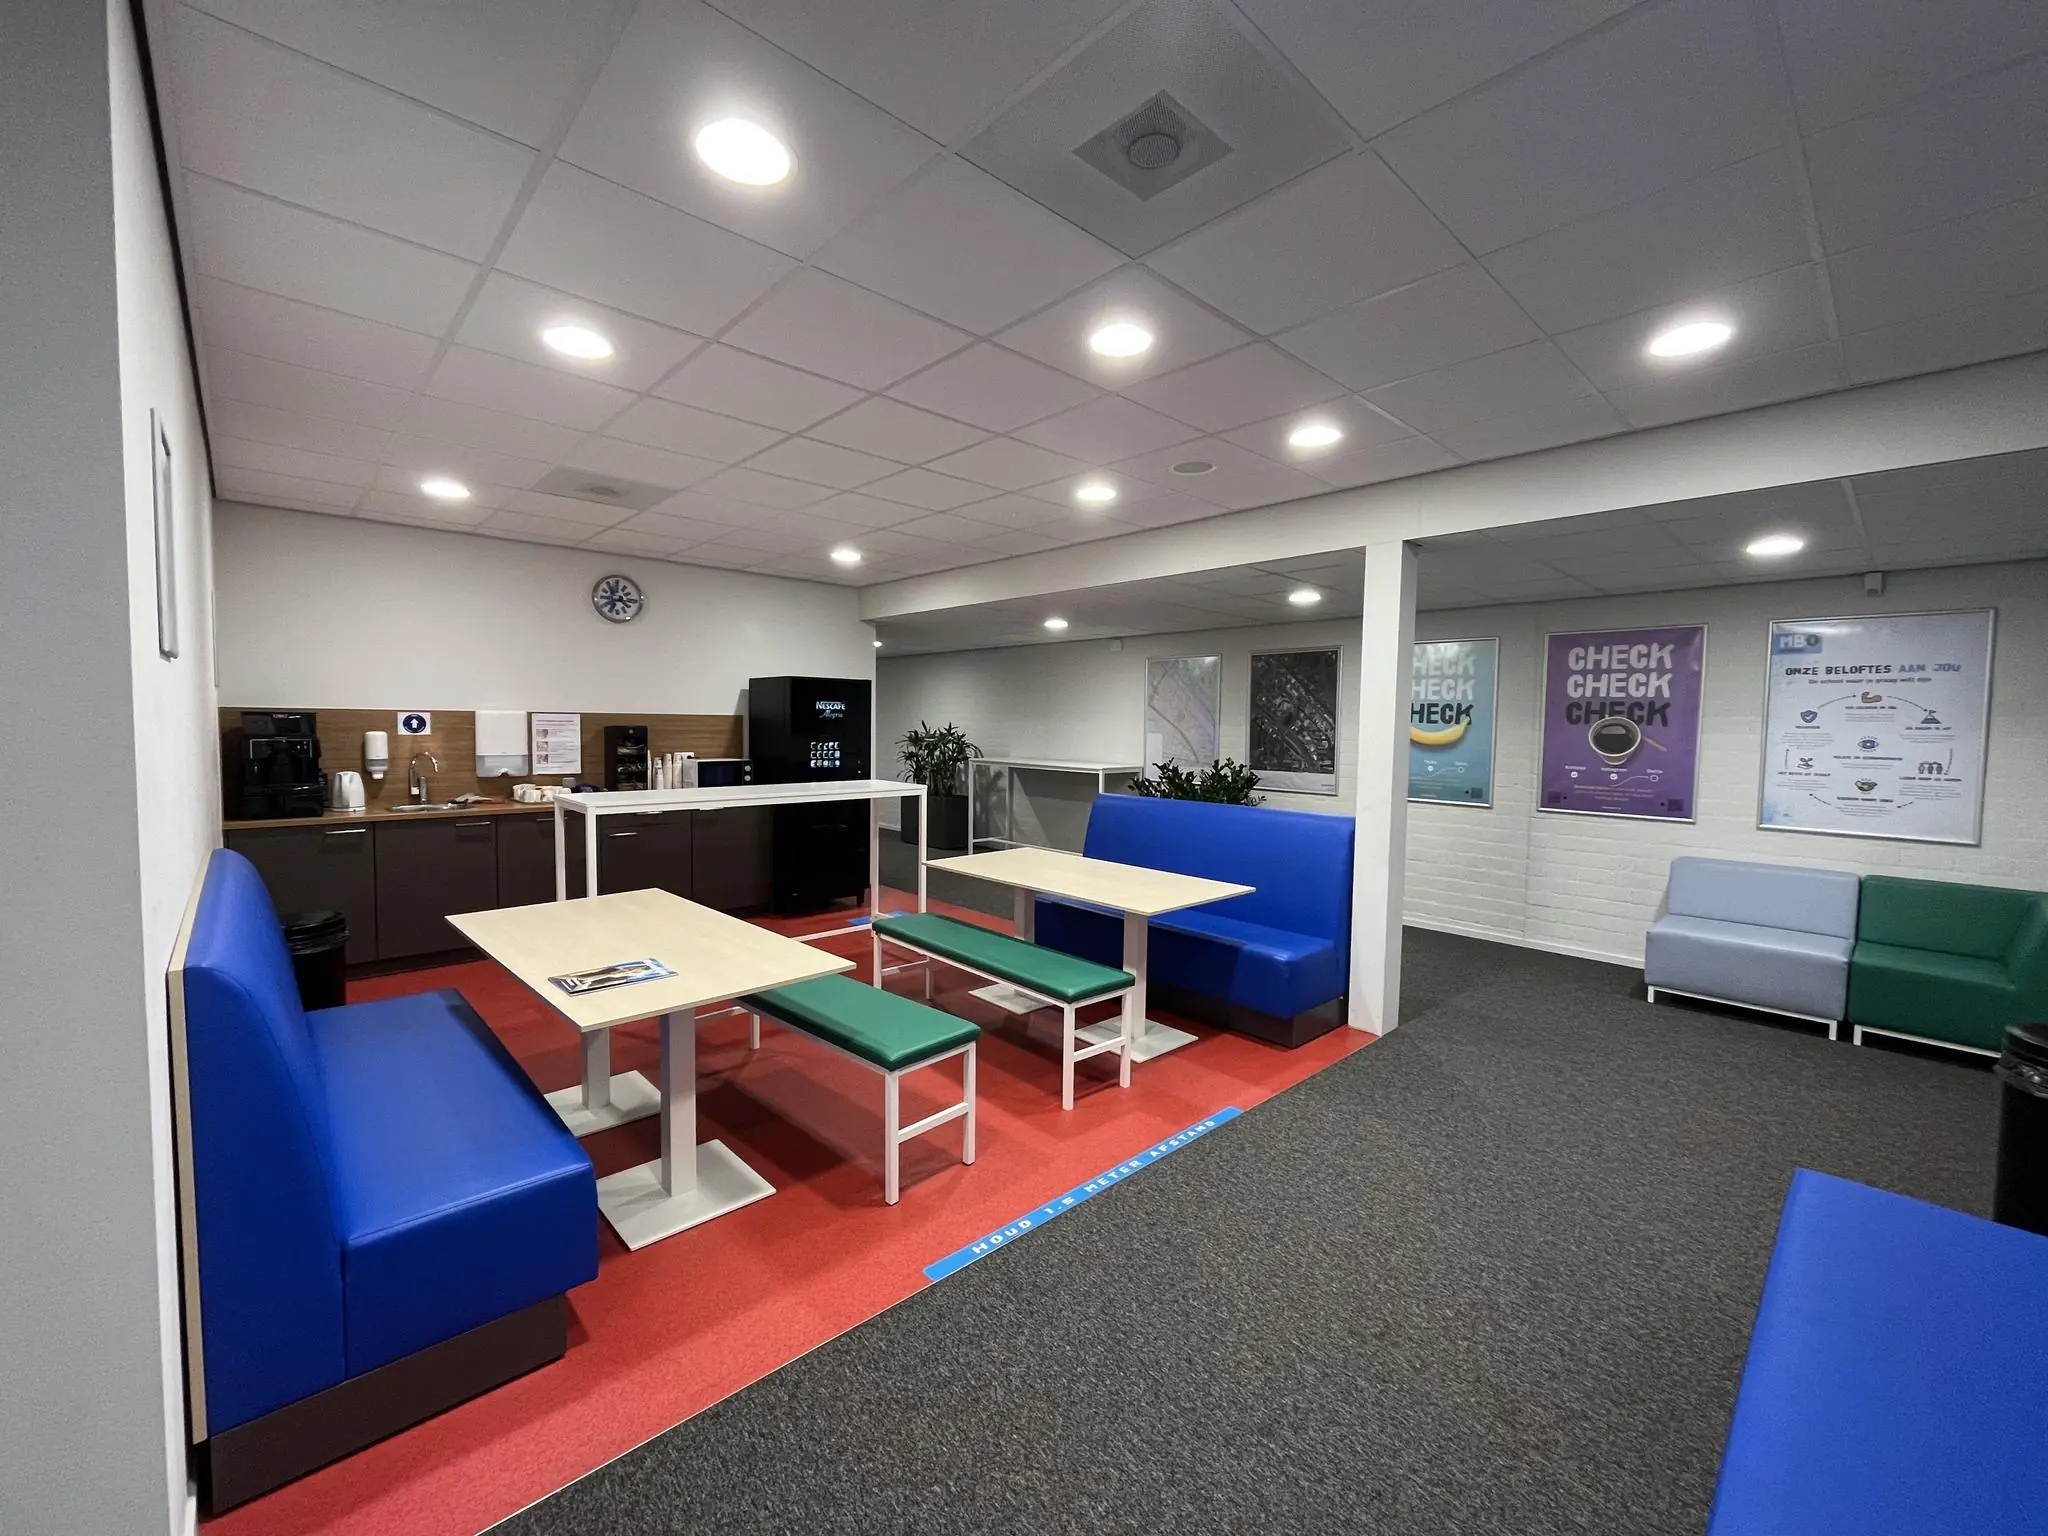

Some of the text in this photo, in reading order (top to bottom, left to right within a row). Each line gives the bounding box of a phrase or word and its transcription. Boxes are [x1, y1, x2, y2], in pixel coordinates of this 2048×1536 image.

[1412, 654, 1475, 676] HECK
[1568, 643, 1675, 671] CHECK
[1785, 663, 1961, 676] ONZE BELOFTES AAN JOU
[1411, 678, 1475, 700] HECK
[1567, 672, 1673, 698] CHECK
[1410, 702, 1474, 725] HECK
[1566, 701, 1672, 727] CHECK
[971, 1220, 1032, 1254] HOUD
[1083, 1160, 1143, 1193] METER
[1149, 1120, 1216, 1157] AFSTAND
